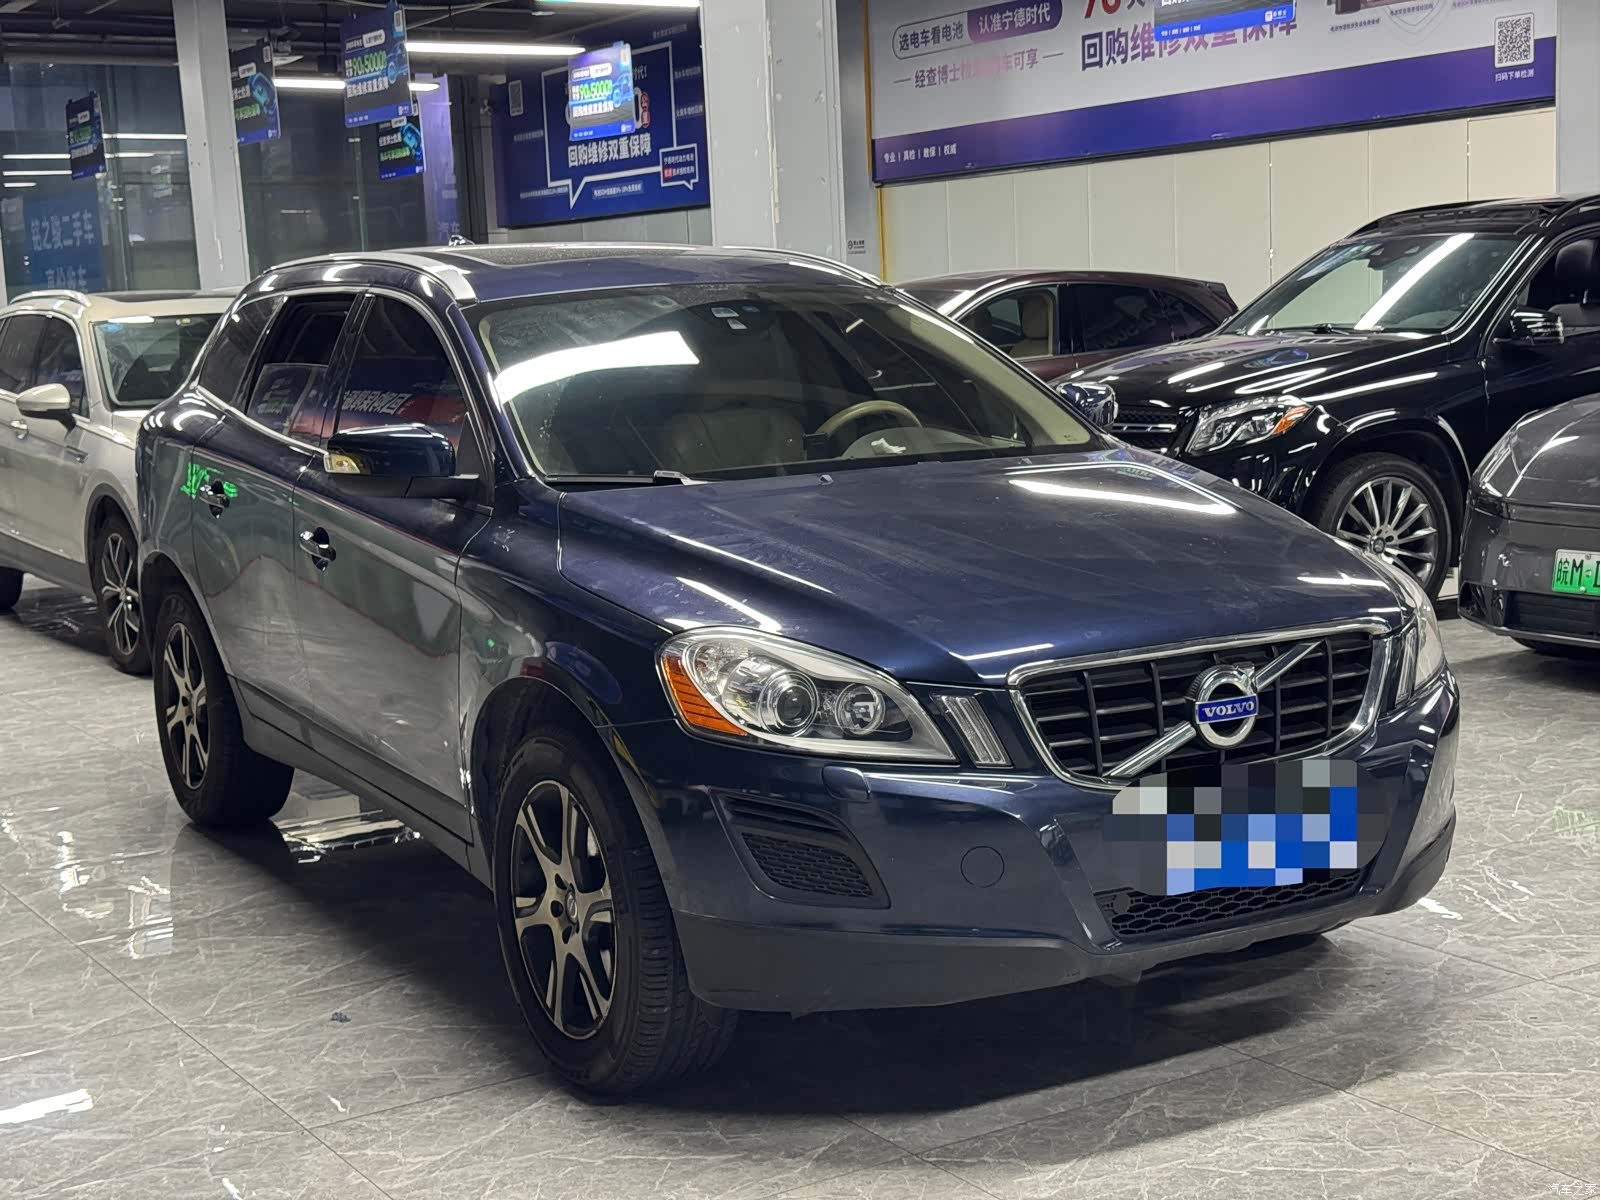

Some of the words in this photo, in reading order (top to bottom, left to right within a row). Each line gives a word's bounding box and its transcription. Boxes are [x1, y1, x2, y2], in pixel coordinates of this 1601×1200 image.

[978, 3, 1051, 34] 认准宁德时代
[899, 20, 964, 52] 选电车看电池
[1495, 69, 1535, 82] 扫码下单检测
[568, 133, 652, 168] 回购维修双重保障
[1202, 701, 1255, 718] VOLVO
